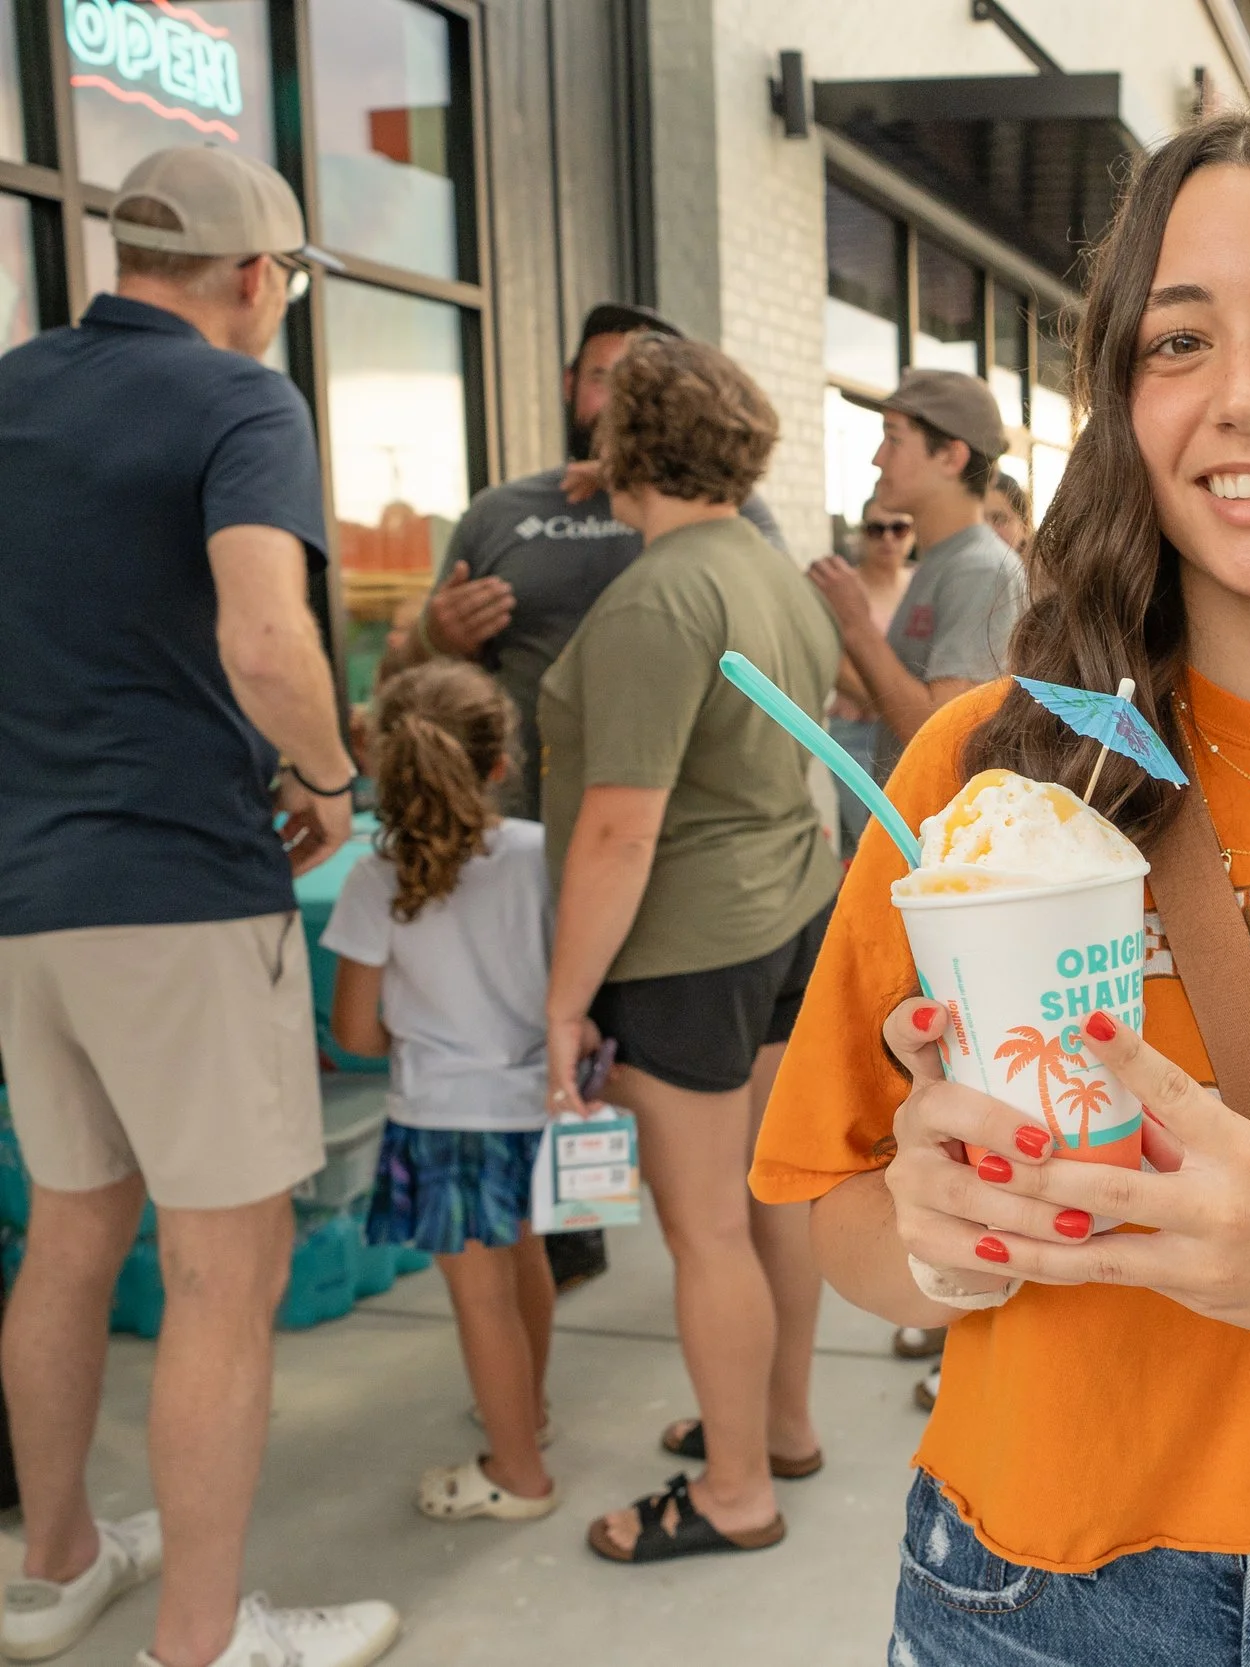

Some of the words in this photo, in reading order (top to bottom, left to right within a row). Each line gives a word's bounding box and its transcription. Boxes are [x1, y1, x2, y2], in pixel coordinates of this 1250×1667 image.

[64, 0, 242, 116] OPEN
[1056, 930, 1144, 979] ORIGI
[1039, 967, 1144, 1021] SHAVE
[947, 998, 971, 1056] WARNING!
